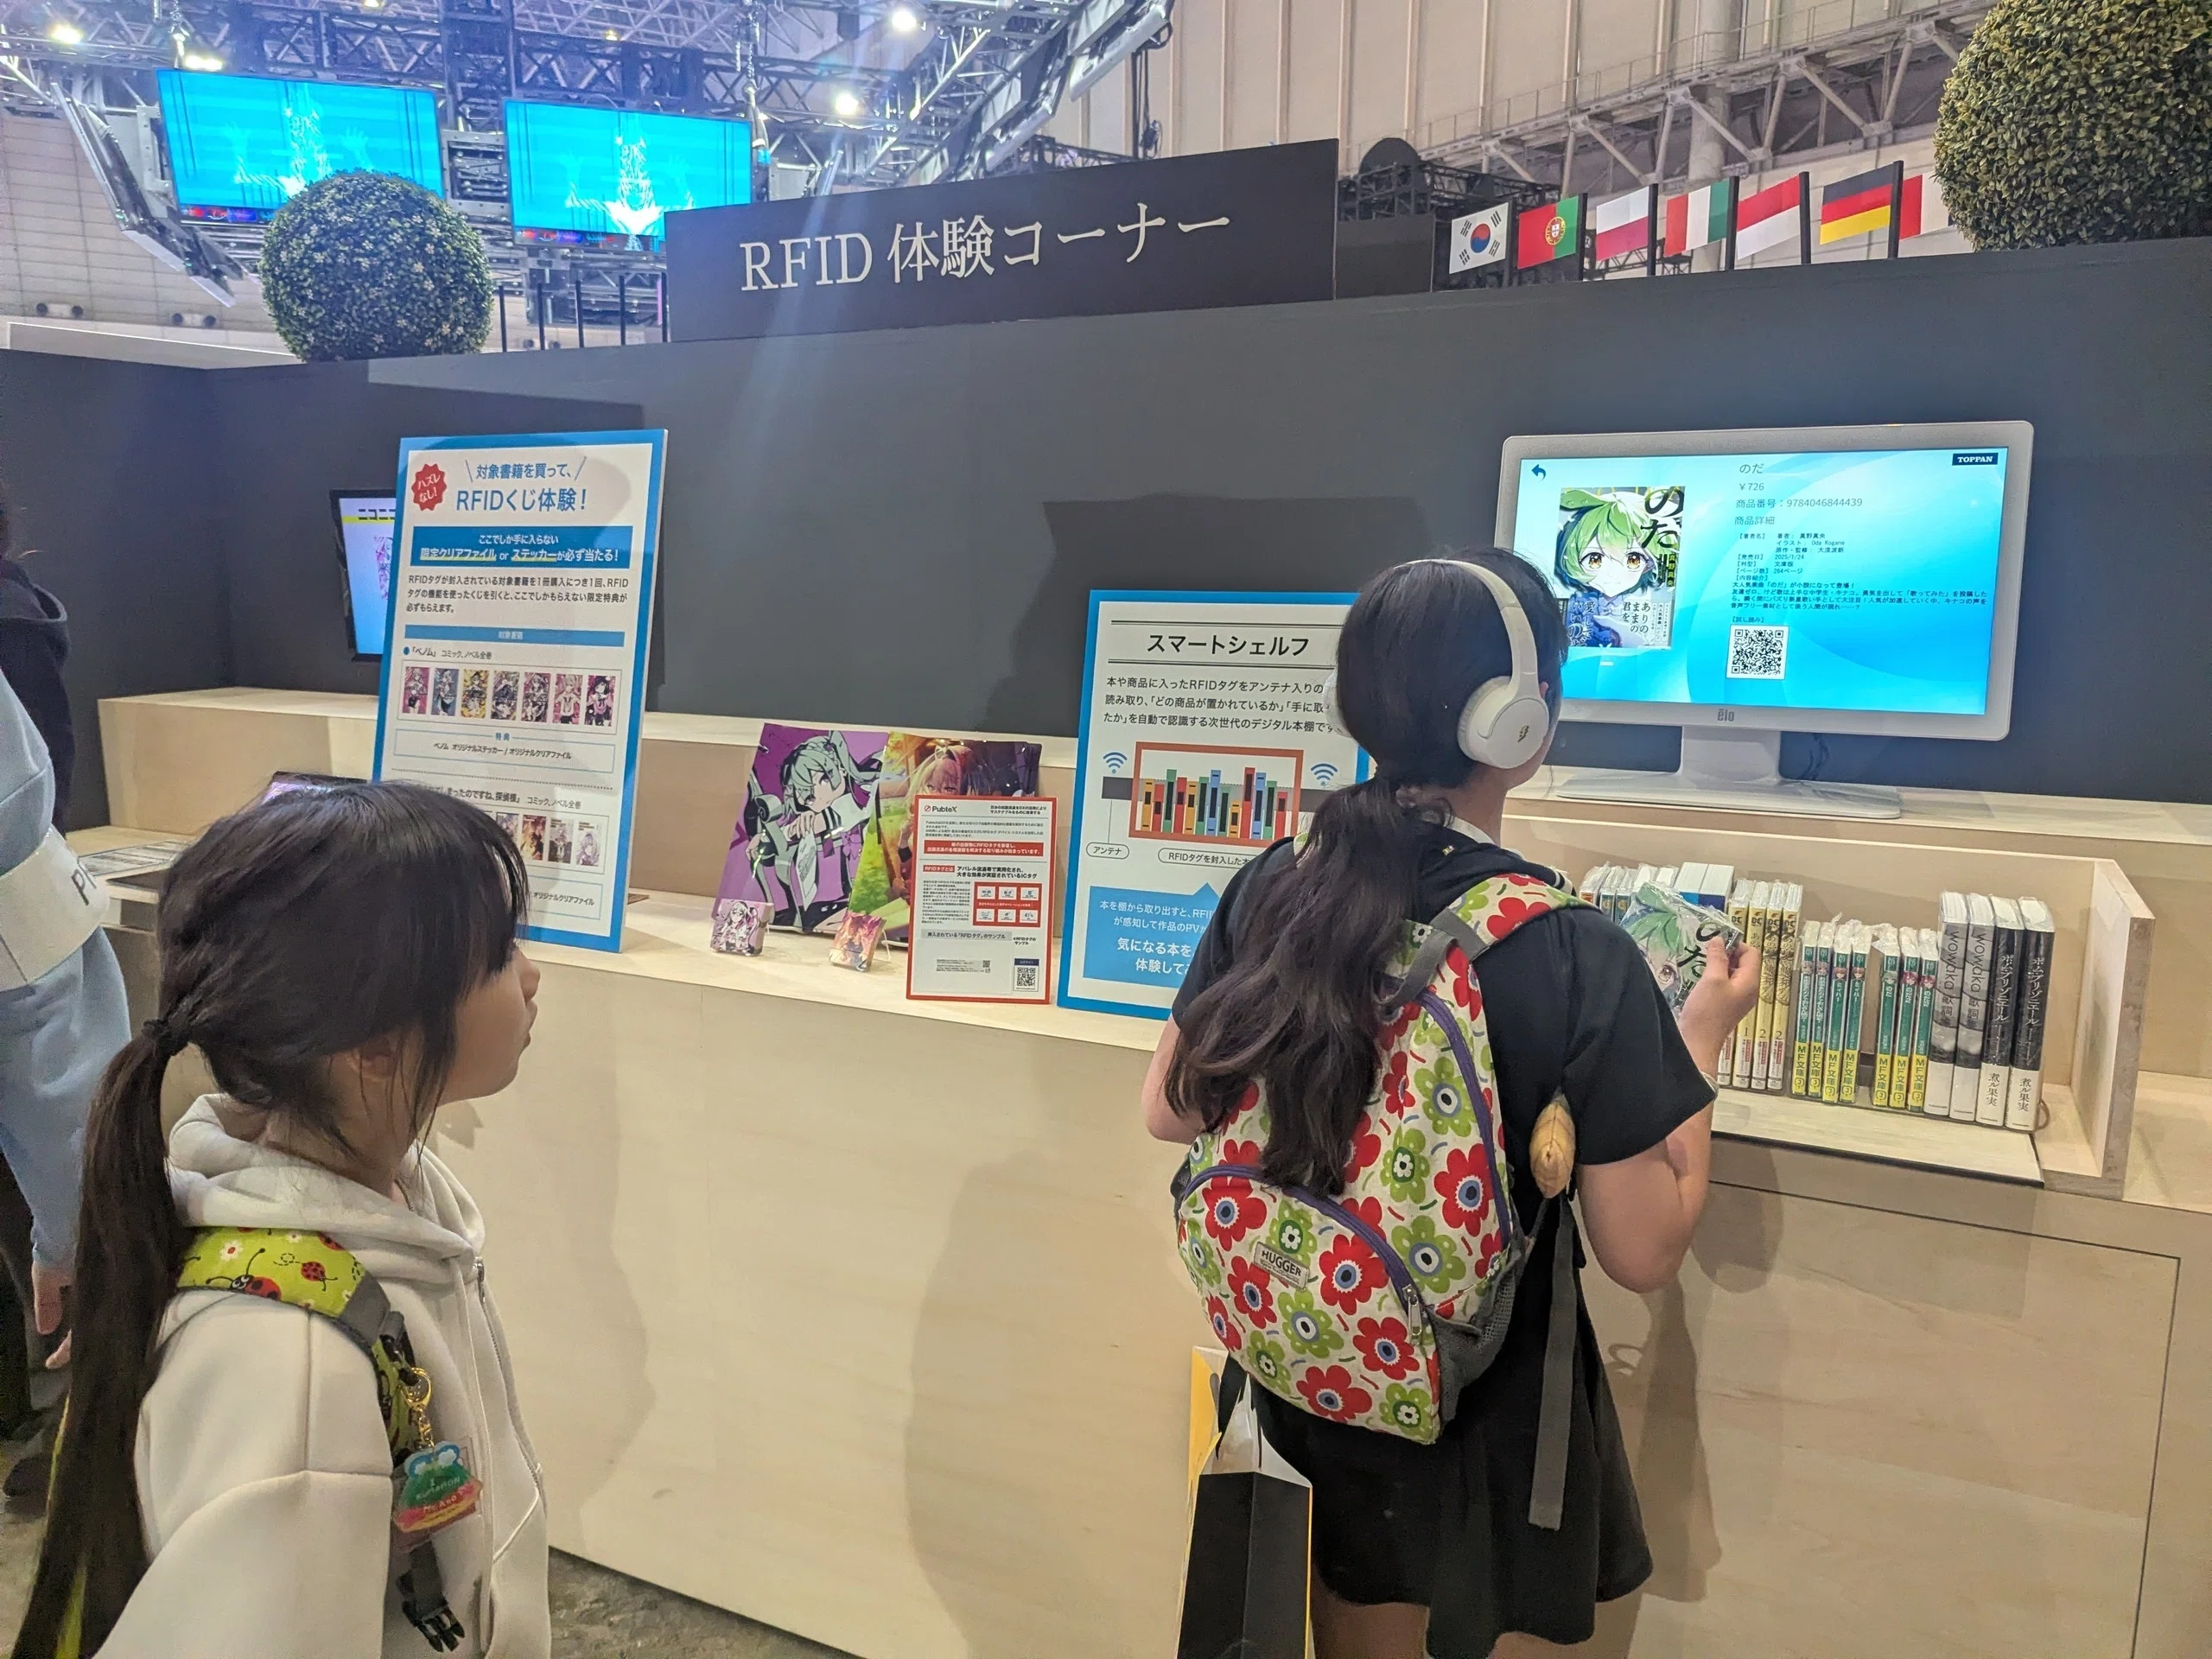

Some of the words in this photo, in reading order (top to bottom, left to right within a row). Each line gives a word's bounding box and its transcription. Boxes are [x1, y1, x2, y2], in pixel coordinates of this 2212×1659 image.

[741, 232, 873, 291] RFID
[887, 202, 1230, 283] 体験コーナー
[476, 463, 571, 480] 対象書籍を買って、
[1739, 463, 1764, 474] のだ
[417, 474, 441, 490] ハズレ
[1734, 516, 1775, 525] 商品詳細
[479, 534, 559, 545] ここでしか手に入らない
[406, 603, 454, 613] 必ずもらえます。
[1623, 601, 1631, 622] 君を
[1630, 601, 1640, 632] ままの
[1640, 601, 1650, 633] ありの
[1147, 634, 1310, 657] スマートシェルフ
[1105, 694, 1330, 714] 読み取り、「どの商品が置かれているか」「手に取
[1093, 846, 1122, 855] アンテナ
[1117, 938, 1195, 957] 気になる本を
[1943, 931, 1959, 990] wowaka
[1970, 933, 1986, 993] wowaka
[1760, 1029, 1766, 1038] 2
[1776, 1031, 1782, 1039] 2
[1262, 1250, 1301, 1276] HUGGER
